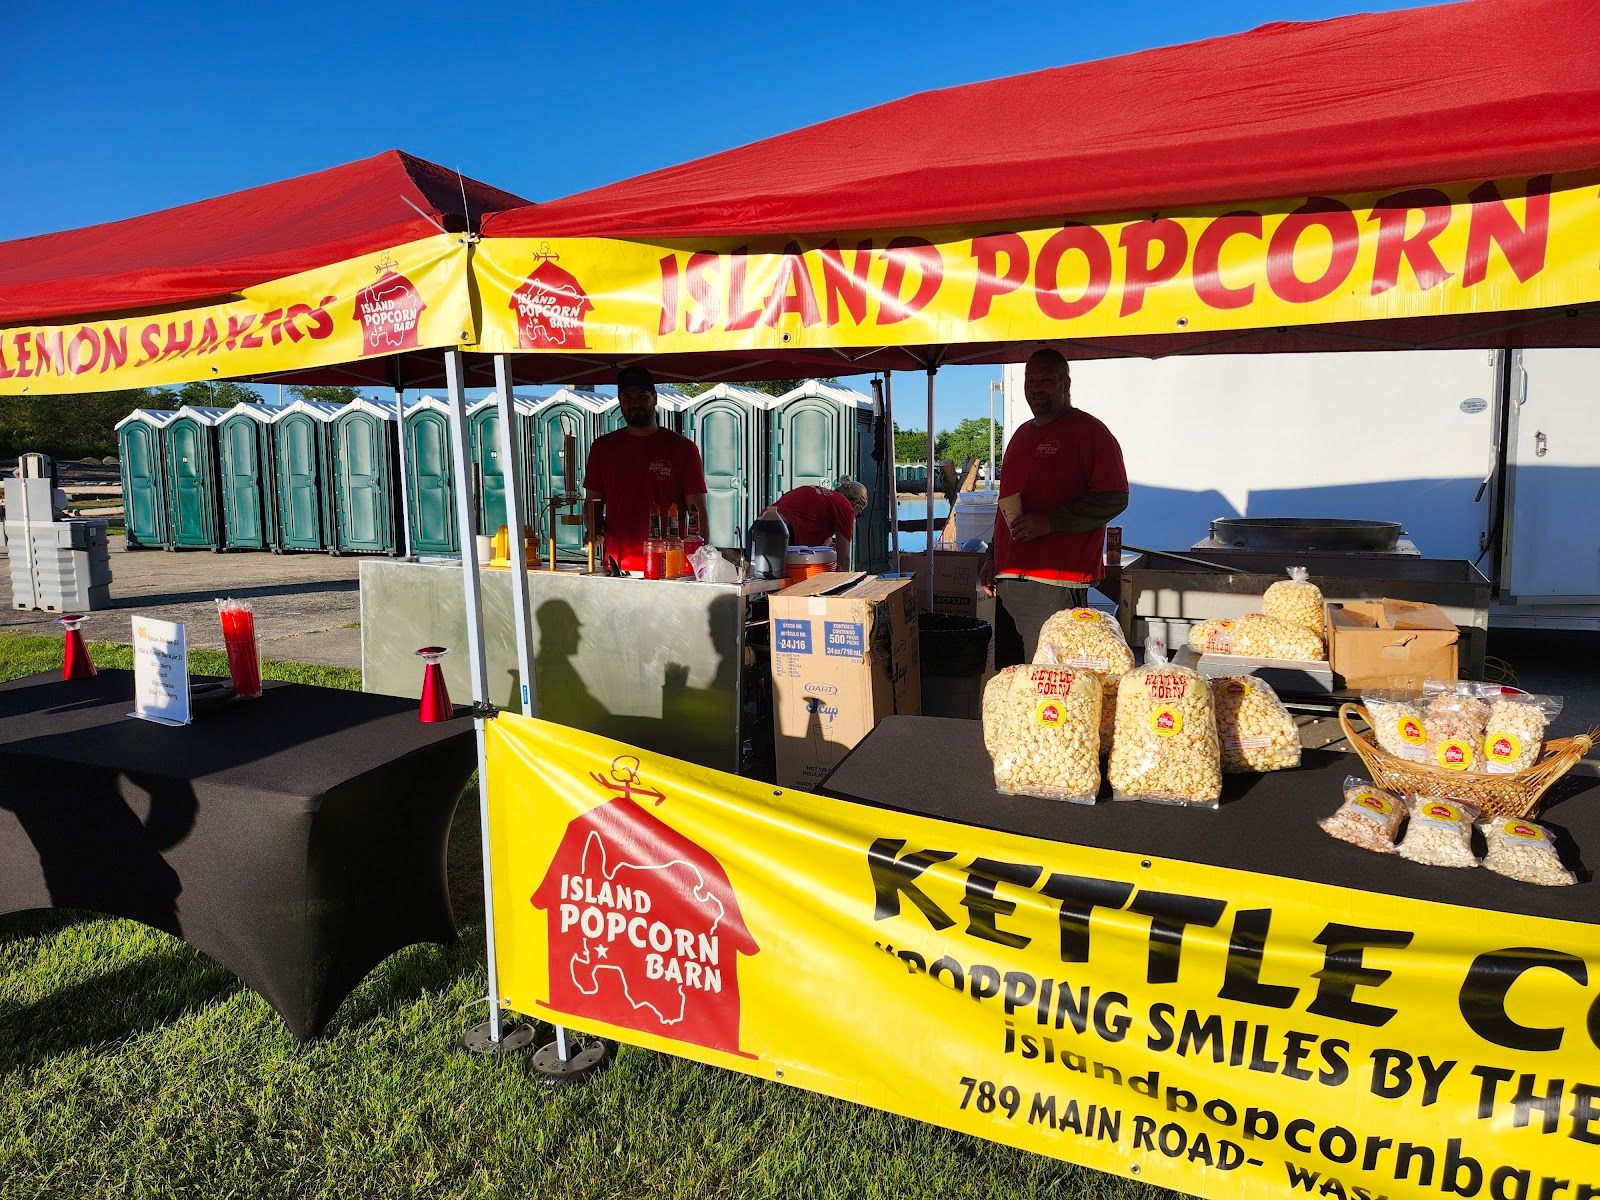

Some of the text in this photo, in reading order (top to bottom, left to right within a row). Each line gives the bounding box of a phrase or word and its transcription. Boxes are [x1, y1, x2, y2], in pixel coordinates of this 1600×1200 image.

[658, 236, 943, 336] ISLAND
[968, 174, 1552, 322] POPCORN
[517, 293, 557, 305] ISLAND
[360, 300, 395, 314] ISLAND
[518, 304, 580, 318] POPCORN
[363, 308, 417, 328] POPCORN
[549, 317, 578, 329] BARN
[393, 320, 416, 333] BARN
[781, 639, 806, 650] 24J16
[829, 634, 845, 644] 500
[1030, 669, 1073, 684] KETTLE
[1144, 674, 1186, 686] KETTLE
[808, 684, 833, 693] DART
[560, 873, 652, 914] ISLAND
[560, 903, 719, 967] POPCORN
[867, 837, 1600, 1052] KETTLE C
[645, 953, 722, 994] BARN
[1147, 1002, 1350, 1087] SMILES
[1369, 1048, 1458, 1107] BY
[1470, 1064, 1600, 1146] THE
[959, 1076, 1021, 1120] 789
[1028, 1092, 1122, 1144] MAIN
